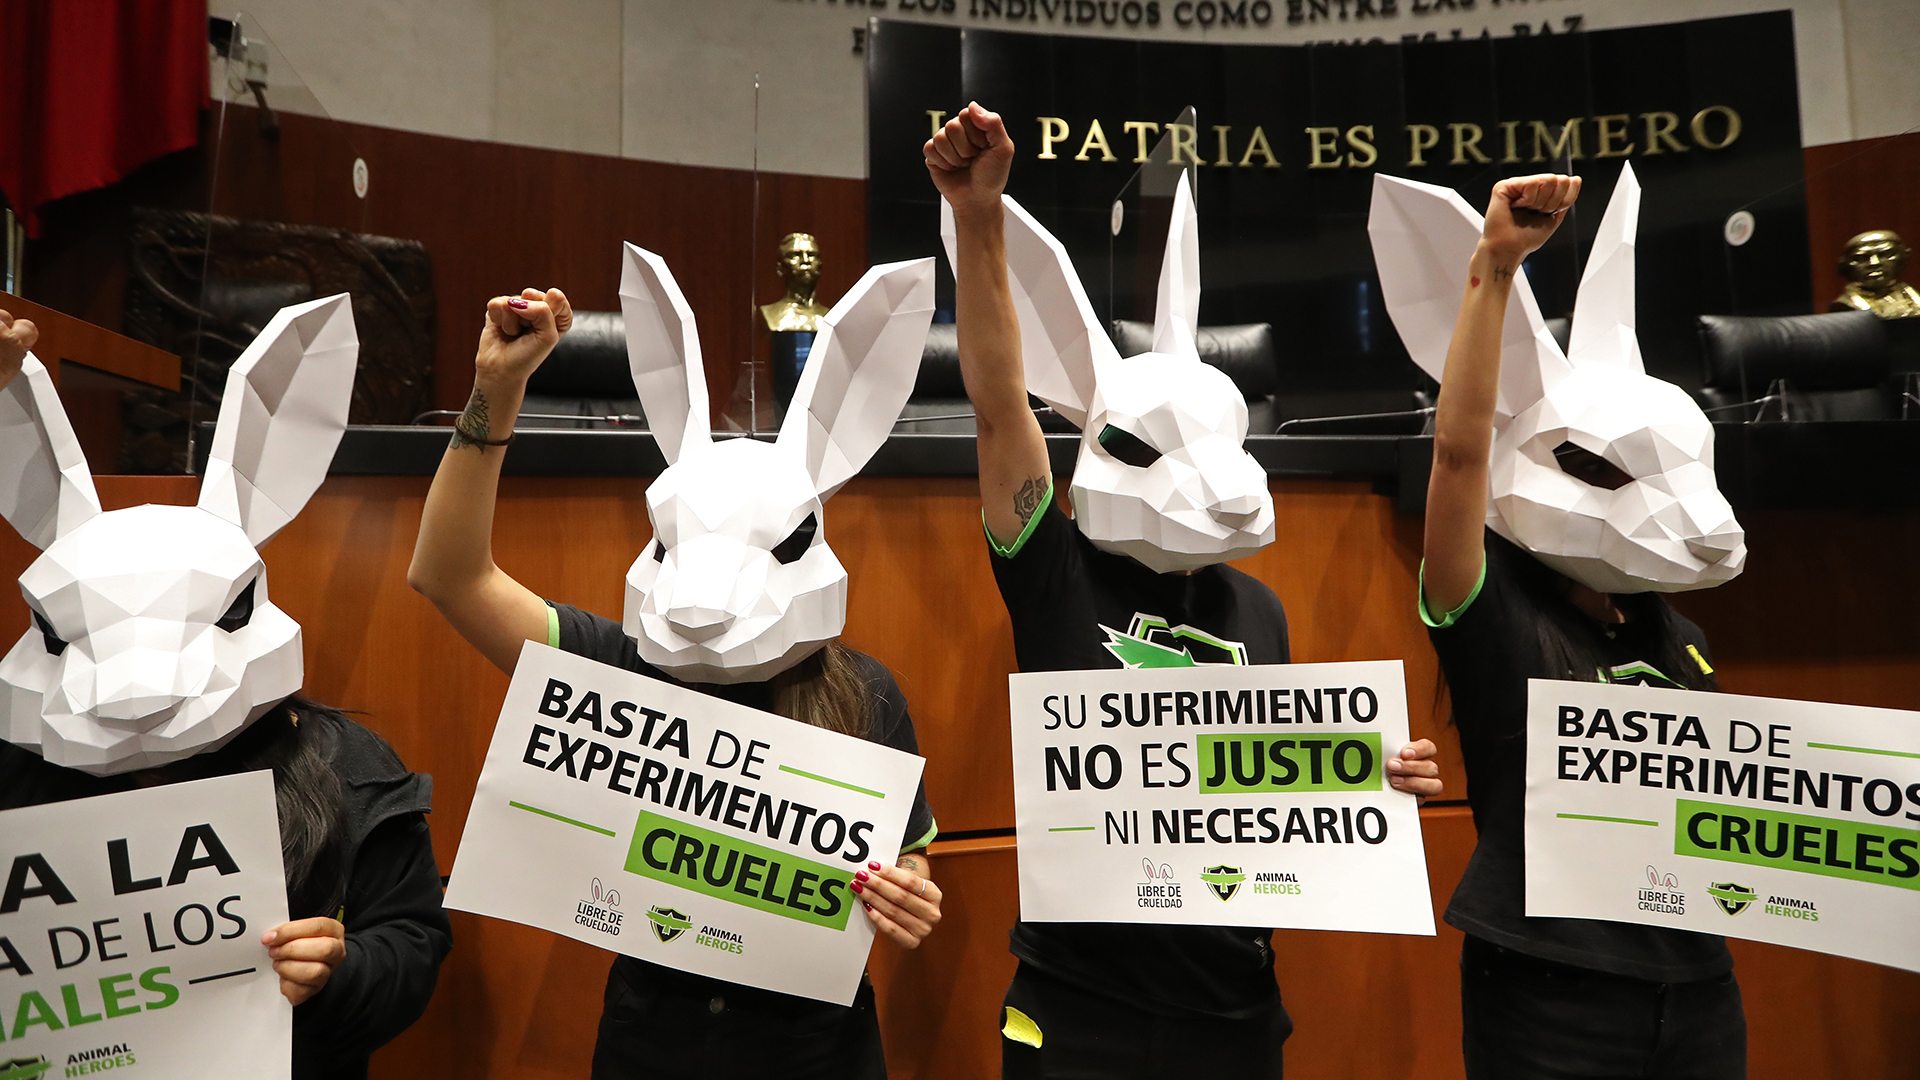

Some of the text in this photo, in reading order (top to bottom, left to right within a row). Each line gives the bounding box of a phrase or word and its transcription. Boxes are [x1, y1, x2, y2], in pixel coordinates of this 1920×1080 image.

[968, 0, 1160, 26] INDIVIDUOS
[1174, 0, 1272, 27] COMO
[1036, 115, 1281, 168] PATRIA
[1304, 124, 1378, 169] ES
[1406, 104, 1742, 167] PRIMERO
[1043, 687, 1378, 730] SU SUFRIMIENTO
[538, 678, 770, 780] BASTA DE
[1558, 706, 1791, 758] BASTA DE
[1045, 740, 1373, 792] NO ES JUSTO
[523, 724, 874, 863] EXPERIMENTOS
[1105, 807, 1387, 844] NI NECESARIO
[1688, 812, 1919, 878] CRUELES
[107, 824, 240, 895] LA
[643, 829, 845, 916] CRUELES
[1253, 883, 1302, 895] HEROES
[1255, 872, 1298, 883] ANIMAL
[1137, 885, 1182, 898] LIBRE DE
[1137, 898, 1183, 909] CRUELDAD
[1639, 891, 1684, 905] LIBRE DE
[1768, 896, 1816, 910] ANIMAL
[578, 903, 623, 925] LIBRE DE
[1639, 902, 1683, 915] CRUELDAD
[1765, 904, 1819, 922] HEROES
[48, 918, 127, 969] DE
[144, 896, 246, 952] LOS
[575, 915, 619, 935] CRUELDAD
[701, 926, 742, 943] ANIMAL
[696, 935, 742, 954] HEROES
[0, 967, 179, 1042] ALES
[64, 1053, 137, 1079] HEROES
[68, 1043, 130, 1064] ANIMAL
